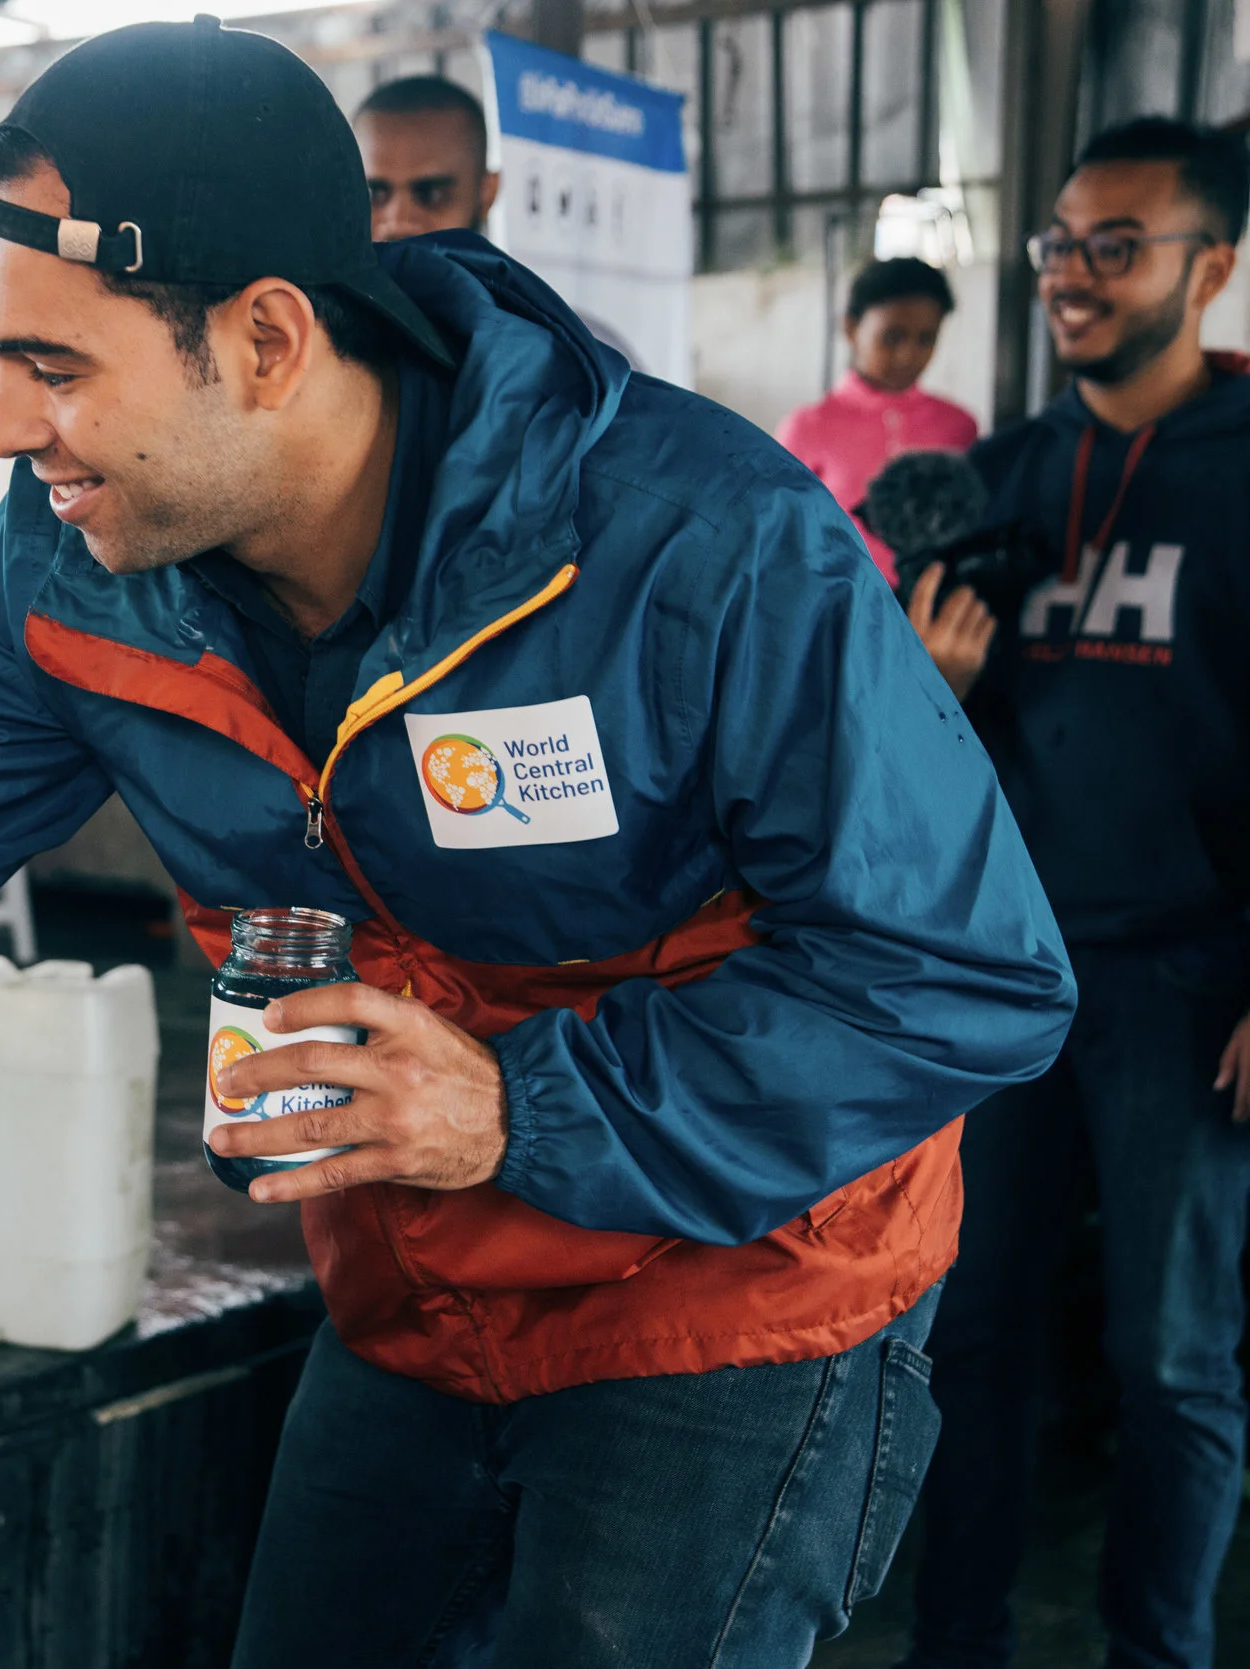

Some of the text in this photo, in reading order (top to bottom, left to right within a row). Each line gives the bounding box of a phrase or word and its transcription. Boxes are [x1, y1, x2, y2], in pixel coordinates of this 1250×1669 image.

[503, 733, 570, 758] World
[513, 752, 594, 780] Central
[518, 778, 604, 802] Kitchen
